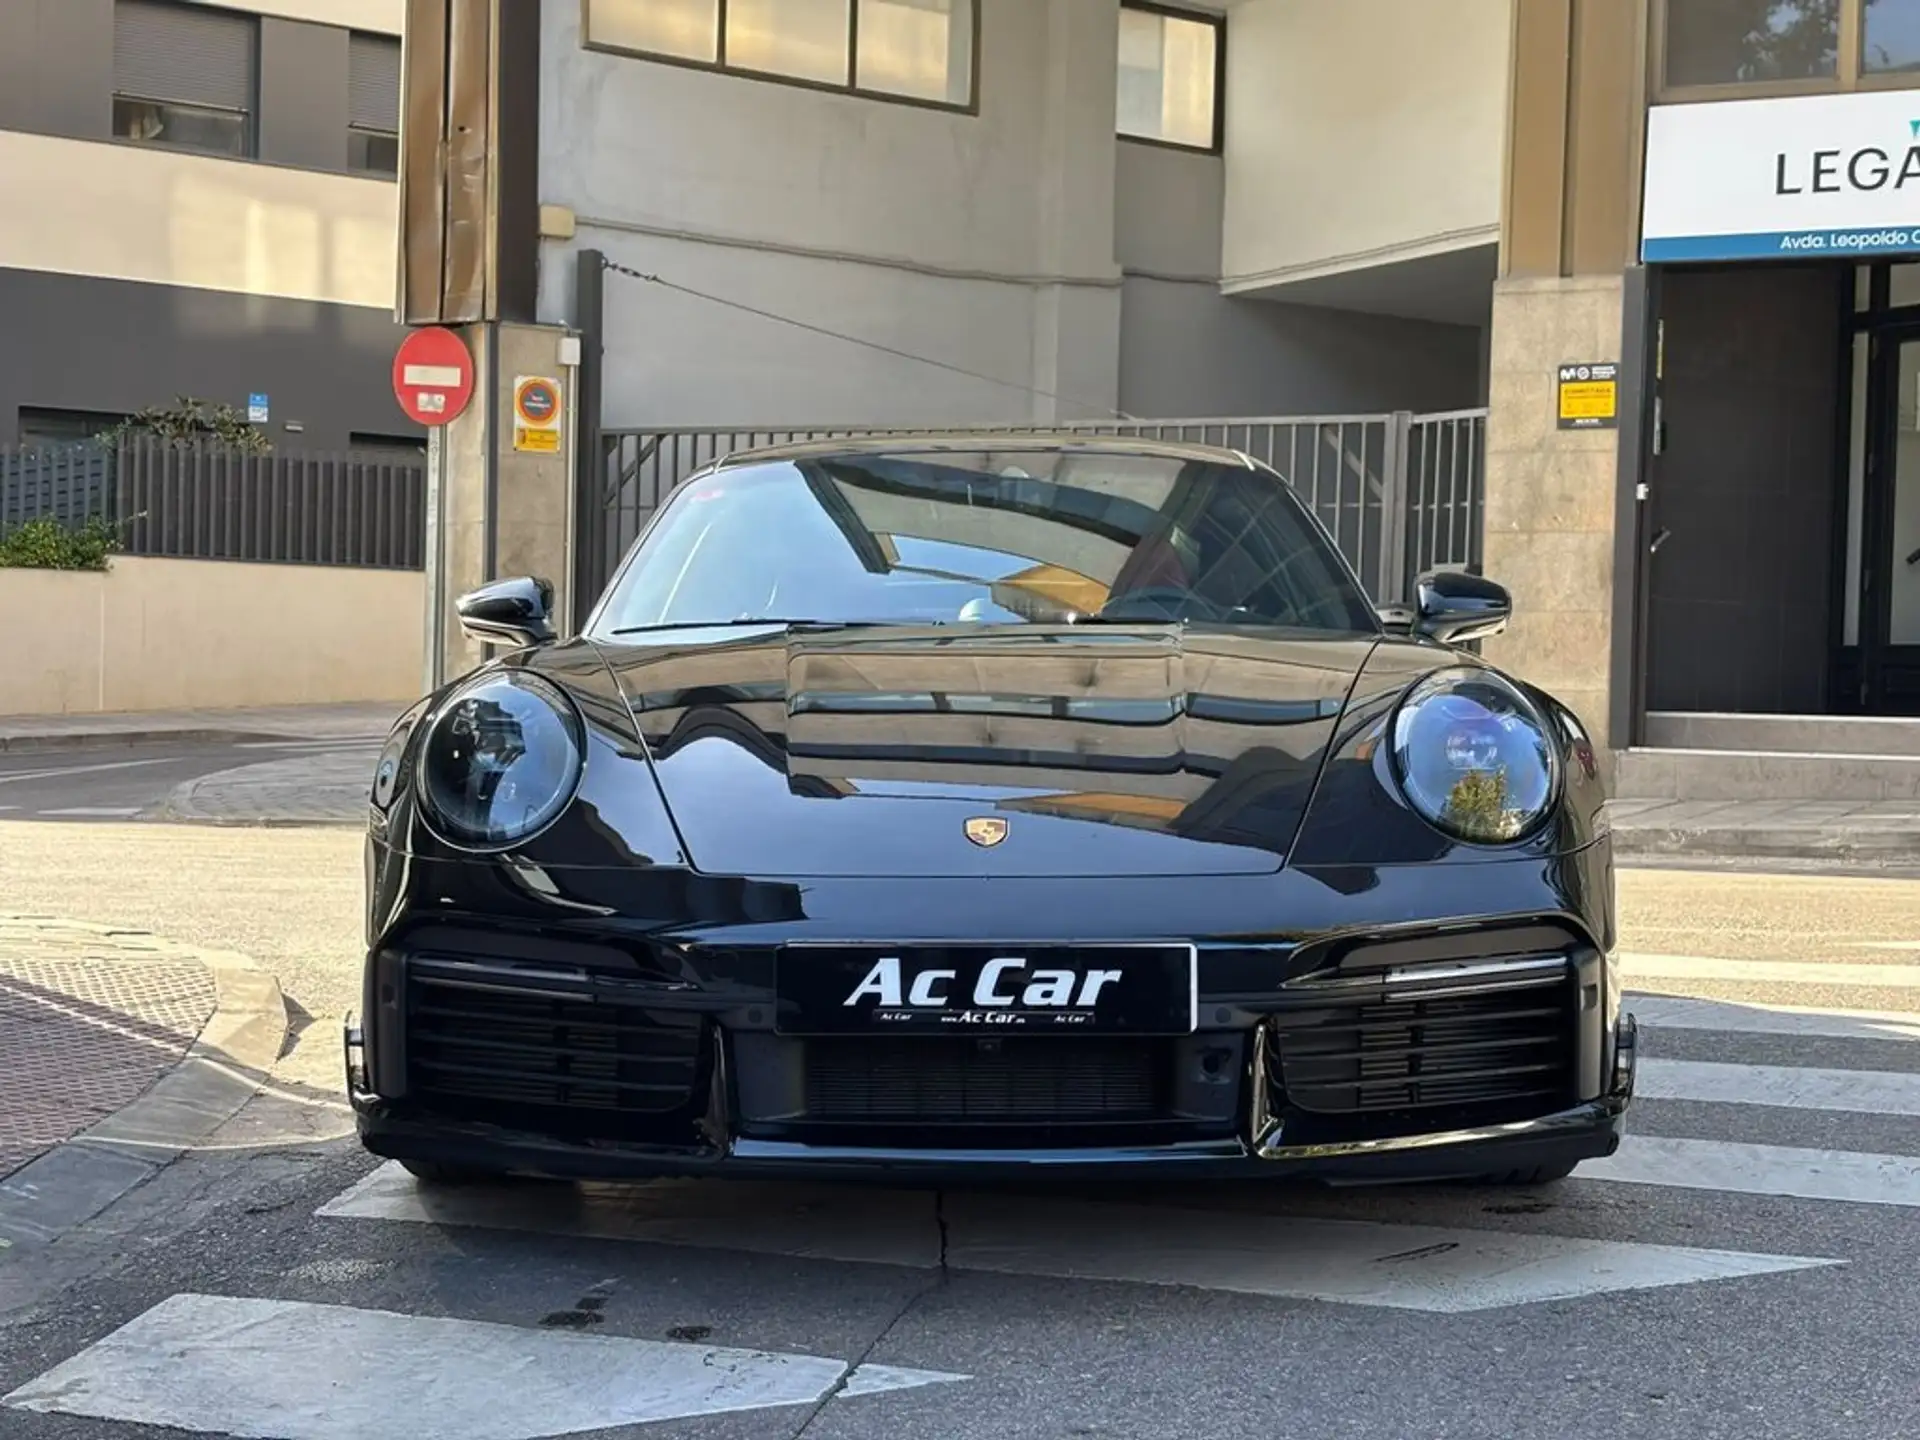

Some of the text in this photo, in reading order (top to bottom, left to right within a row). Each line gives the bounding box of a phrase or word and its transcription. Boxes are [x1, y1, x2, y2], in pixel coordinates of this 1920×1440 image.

[1780, 233, 1828, 250] Avda.
[1830, 229, 1909, 251] Leopoldo
[842, 957, 1123, 1007] Ac Car
